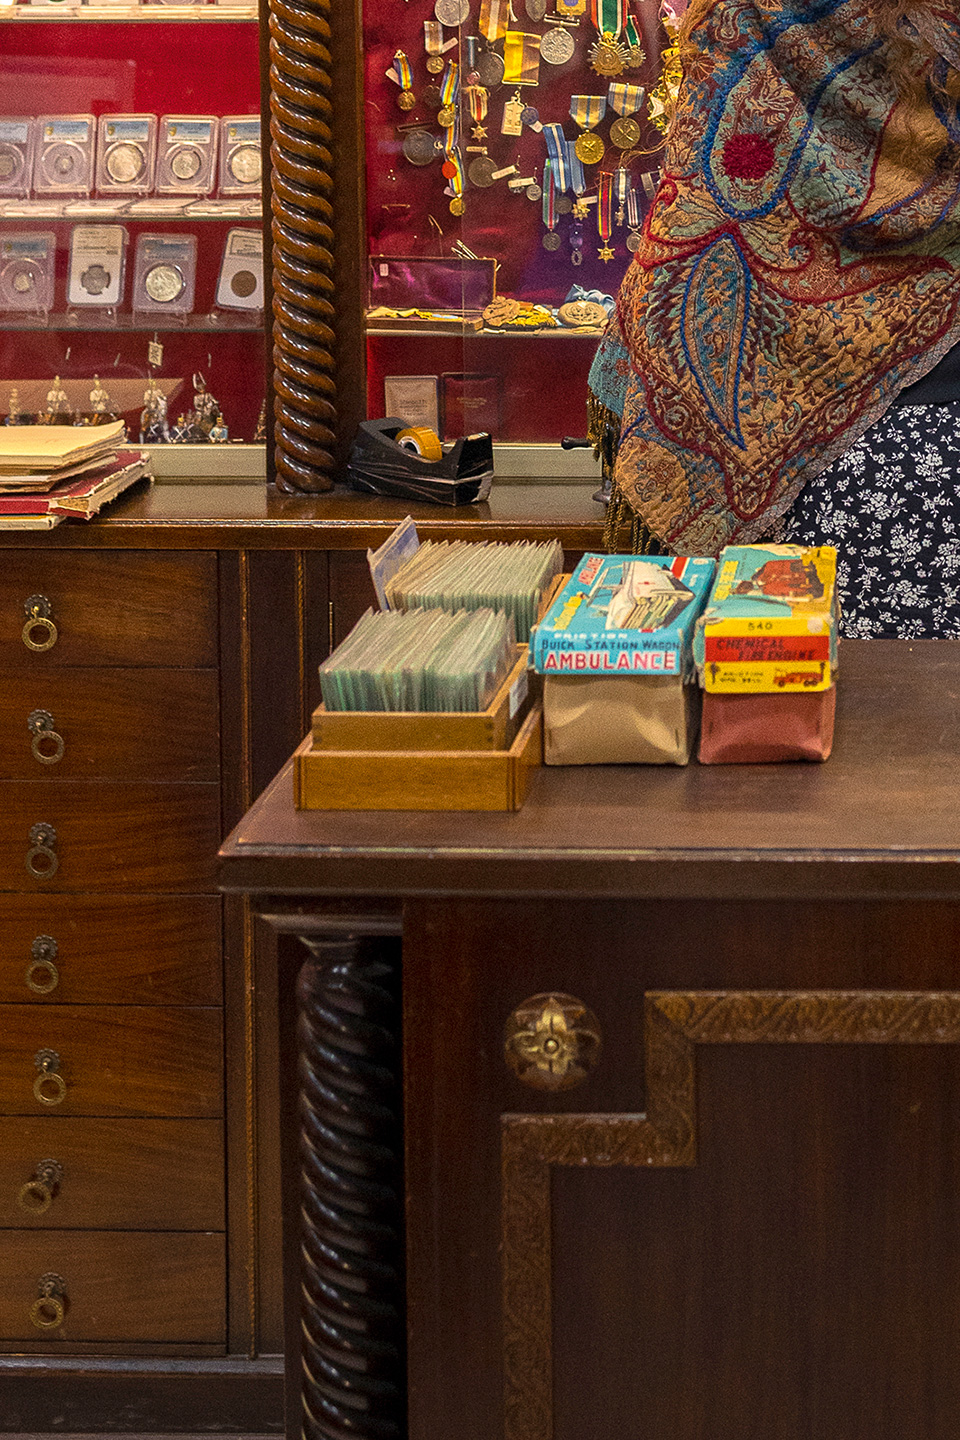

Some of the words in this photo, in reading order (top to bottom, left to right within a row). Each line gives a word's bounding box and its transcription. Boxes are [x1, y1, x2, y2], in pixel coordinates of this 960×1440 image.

[541, 639, 575, 650] BUICK
[585, 639, 638, 650] STATION
[642, 639, 680, 650] WAGON
[543, 651, 677, 670] AMBULANCE
